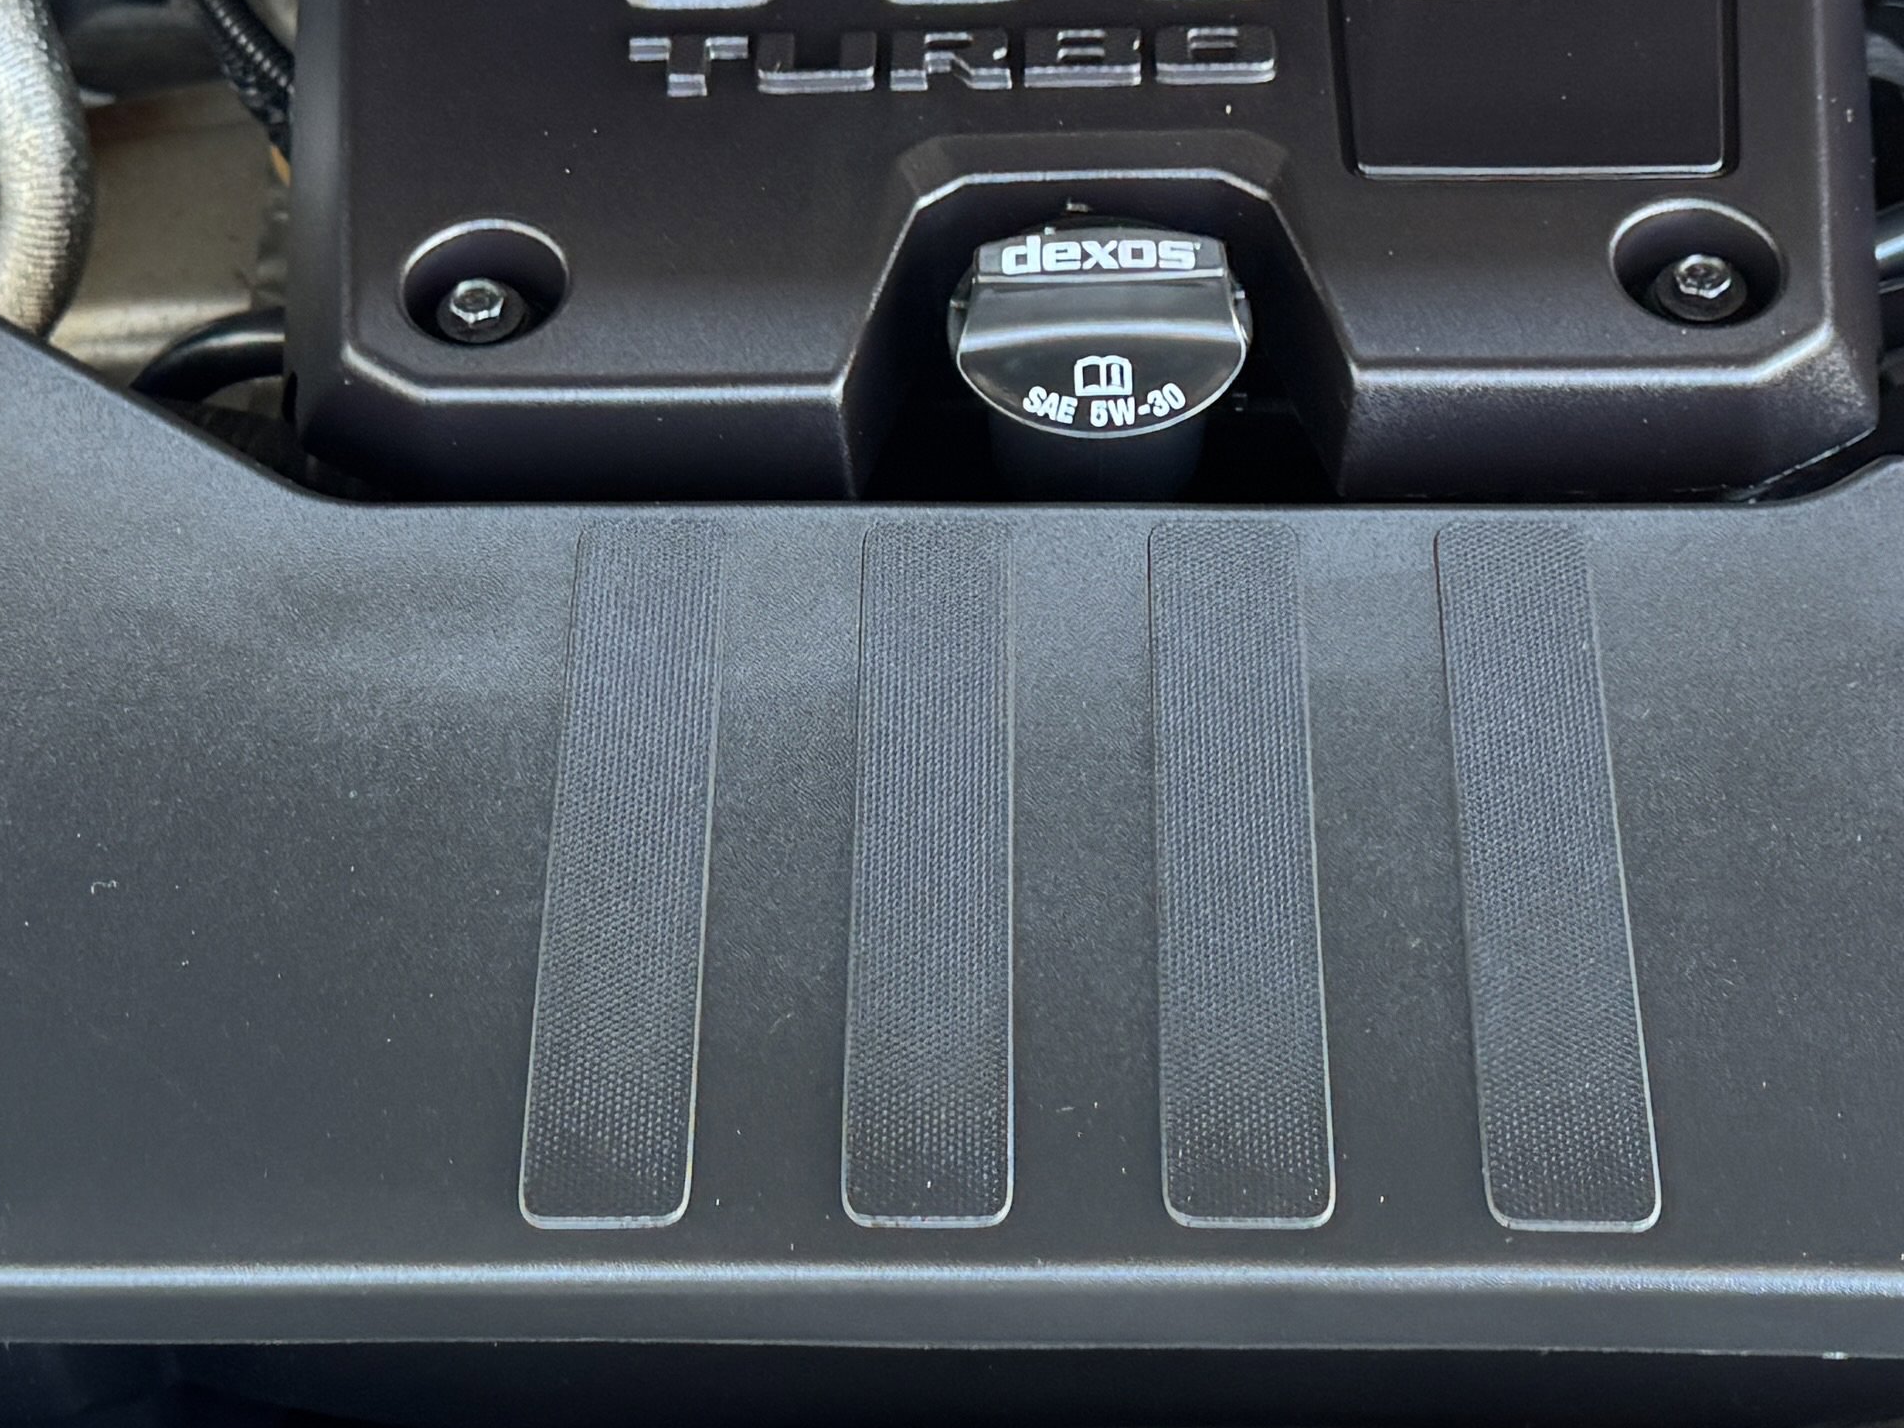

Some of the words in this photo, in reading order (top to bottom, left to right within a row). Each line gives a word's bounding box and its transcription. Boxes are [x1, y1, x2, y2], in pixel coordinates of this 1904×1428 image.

[627, 24, 1278, 99] TURBO
[1000, 233, 1200, 276] dexos
[1022, 385, 1078, 426] SAE
[1089, 382, 1186, 429] 5W-30
